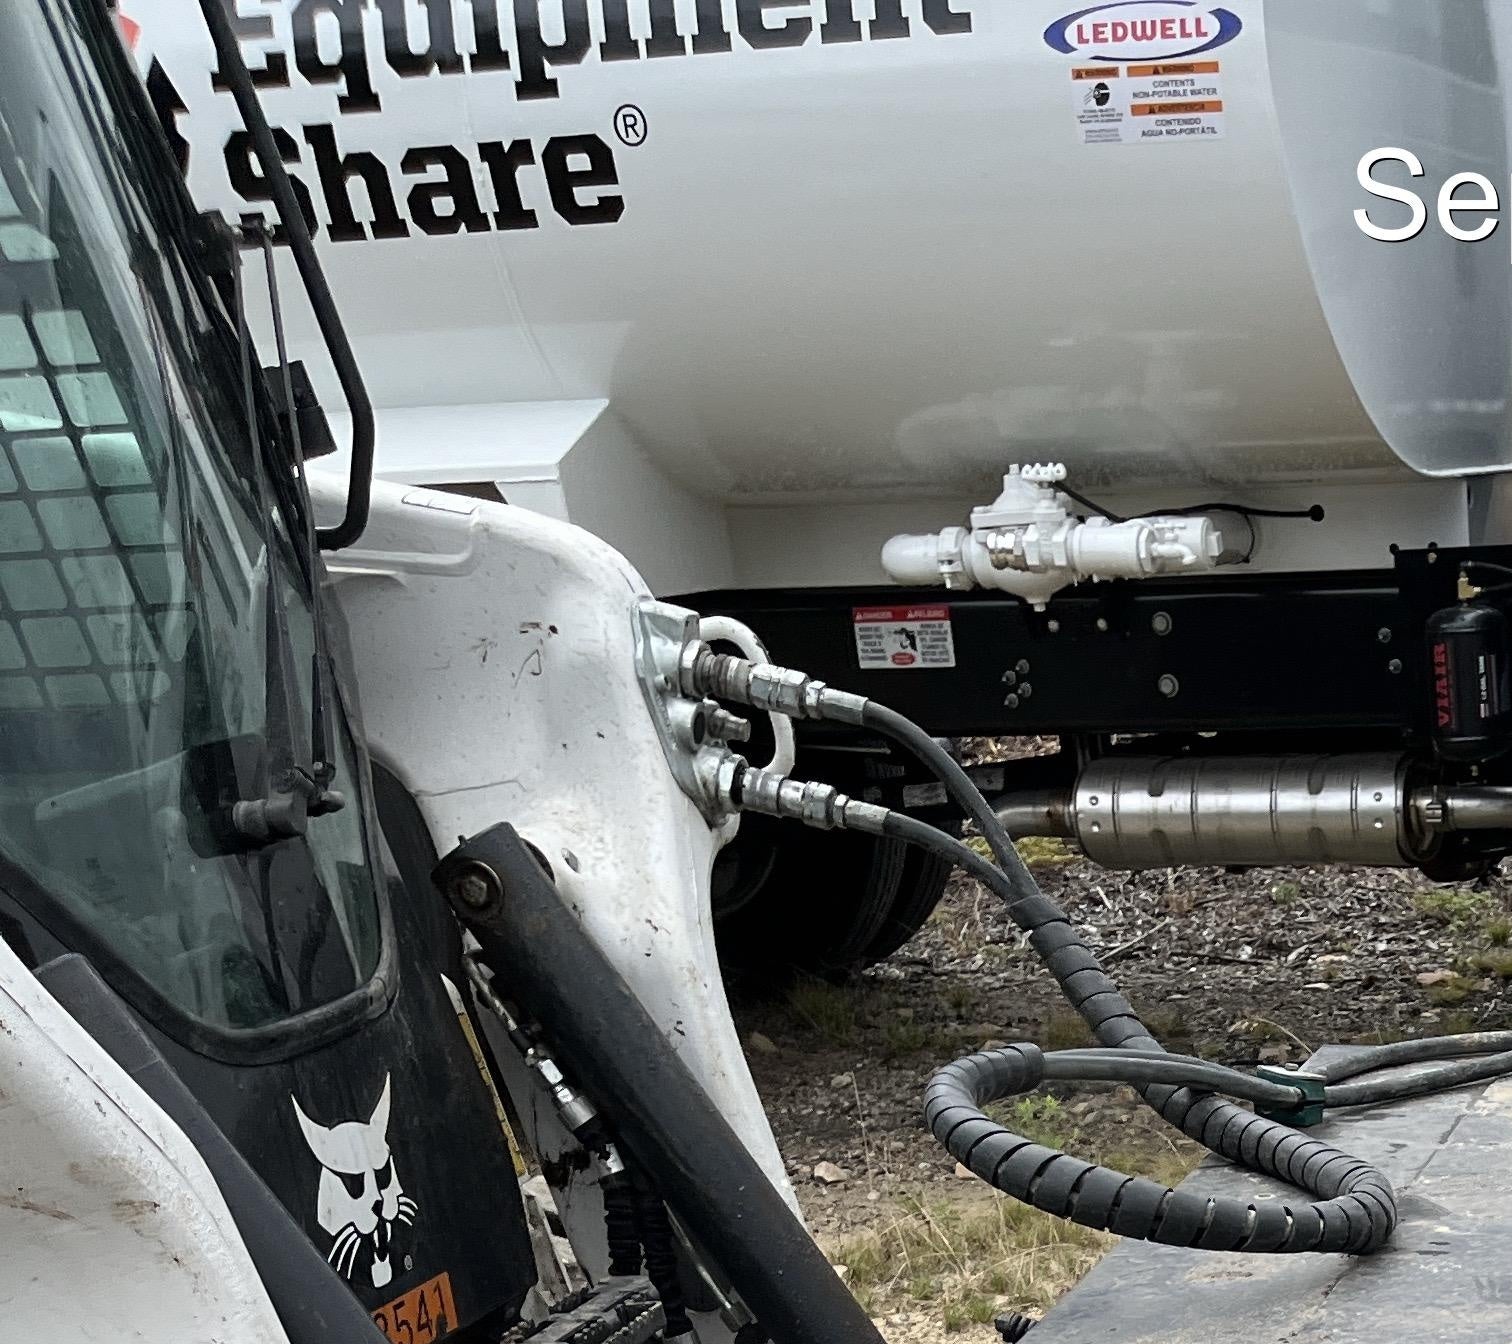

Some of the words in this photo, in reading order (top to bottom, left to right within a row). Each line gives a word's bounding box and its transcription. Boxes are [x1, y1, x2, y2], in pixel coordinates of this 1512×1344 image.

[1077, 17, 1208, 44] LEDWELL
[1152, 78, 1196, 88] CONTENTS
[1132, 90, 1188, 99] NON-POTABLE
[1190, 88, 1218, 97] WATER
[1155, 118, 1201, 127] CONTENIDO
[1141, 128, 1163, 137] AGUA
[1433, 642, 1450, 728] VIAIR
